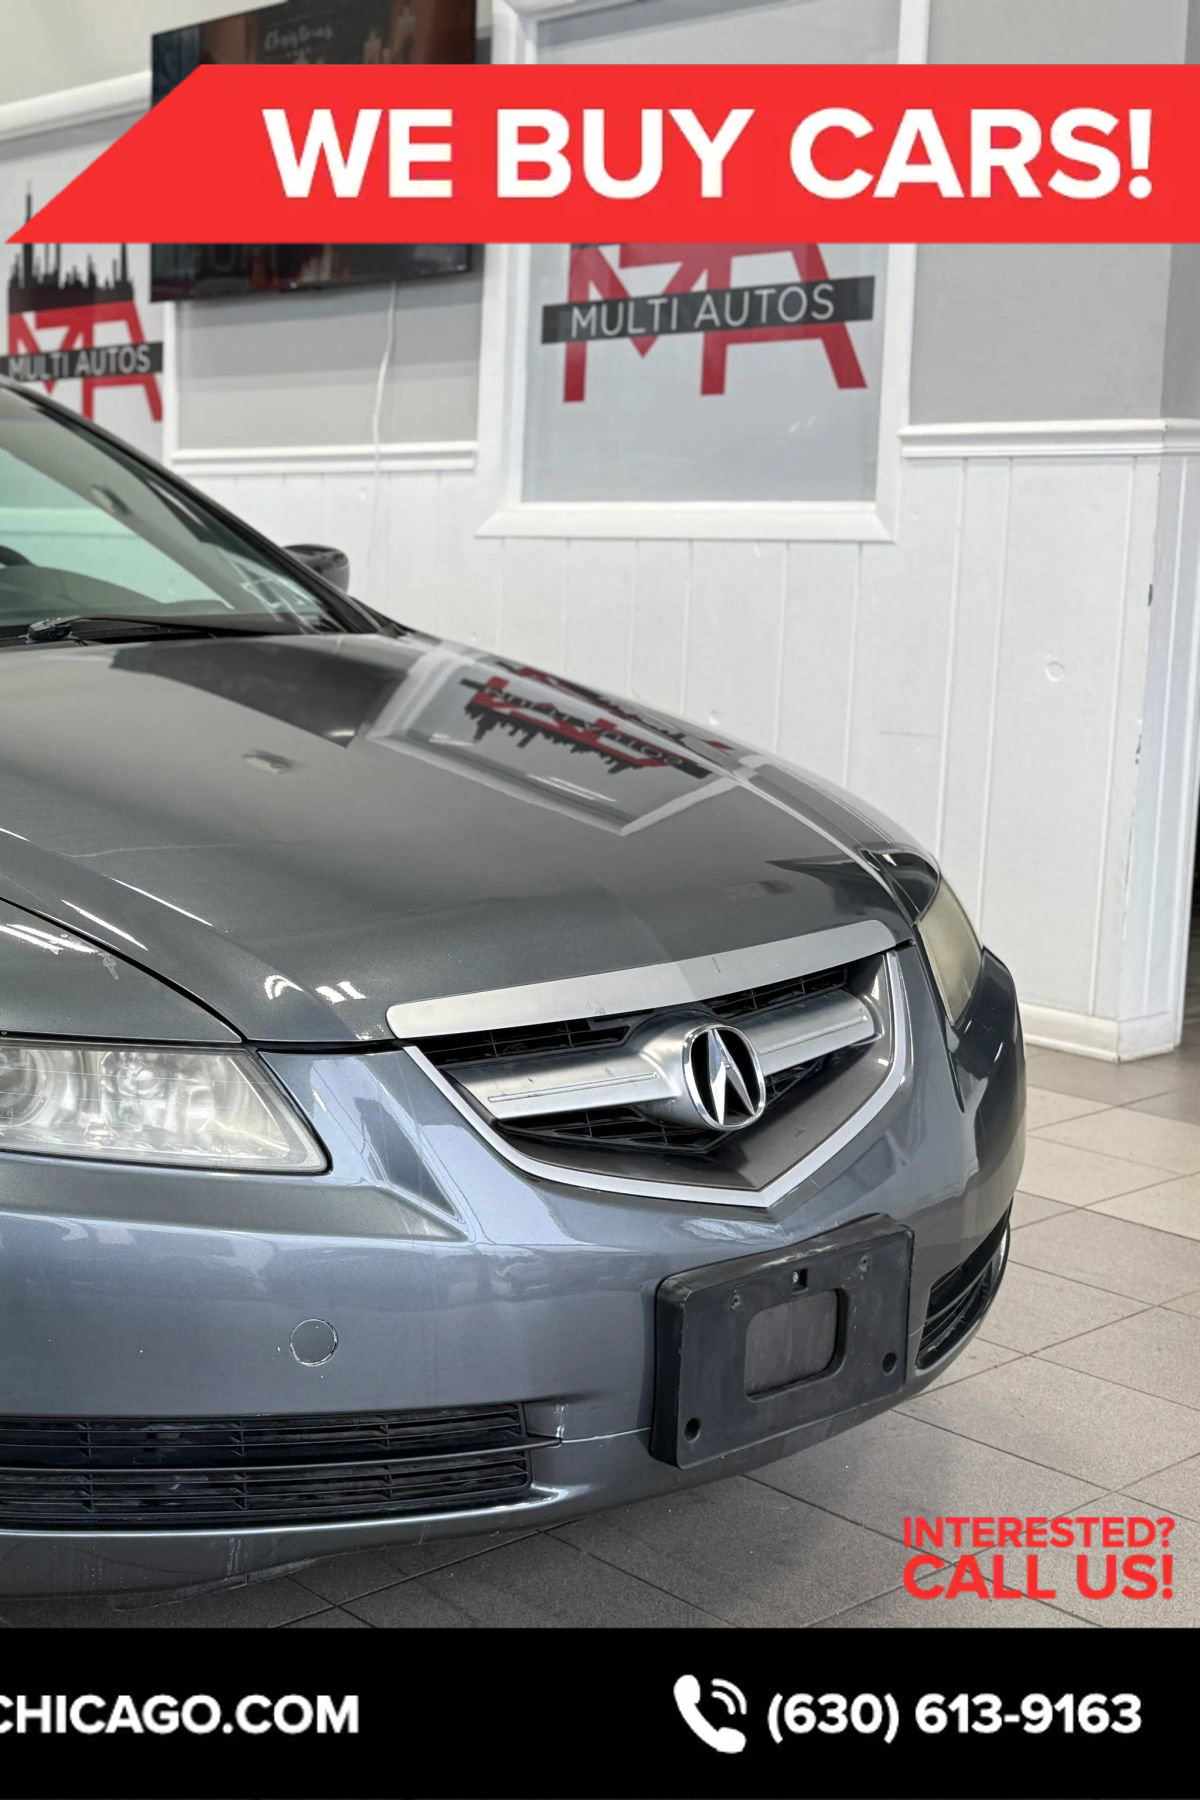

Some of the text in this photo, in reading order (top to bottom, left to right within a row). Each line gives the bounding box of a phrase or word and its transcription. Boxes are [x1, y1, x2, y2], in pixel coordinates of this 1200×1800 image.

[571, 284, 835, 338] MULTI AUTOS
[7, 344, 151, 381] MULTI AUTOS
